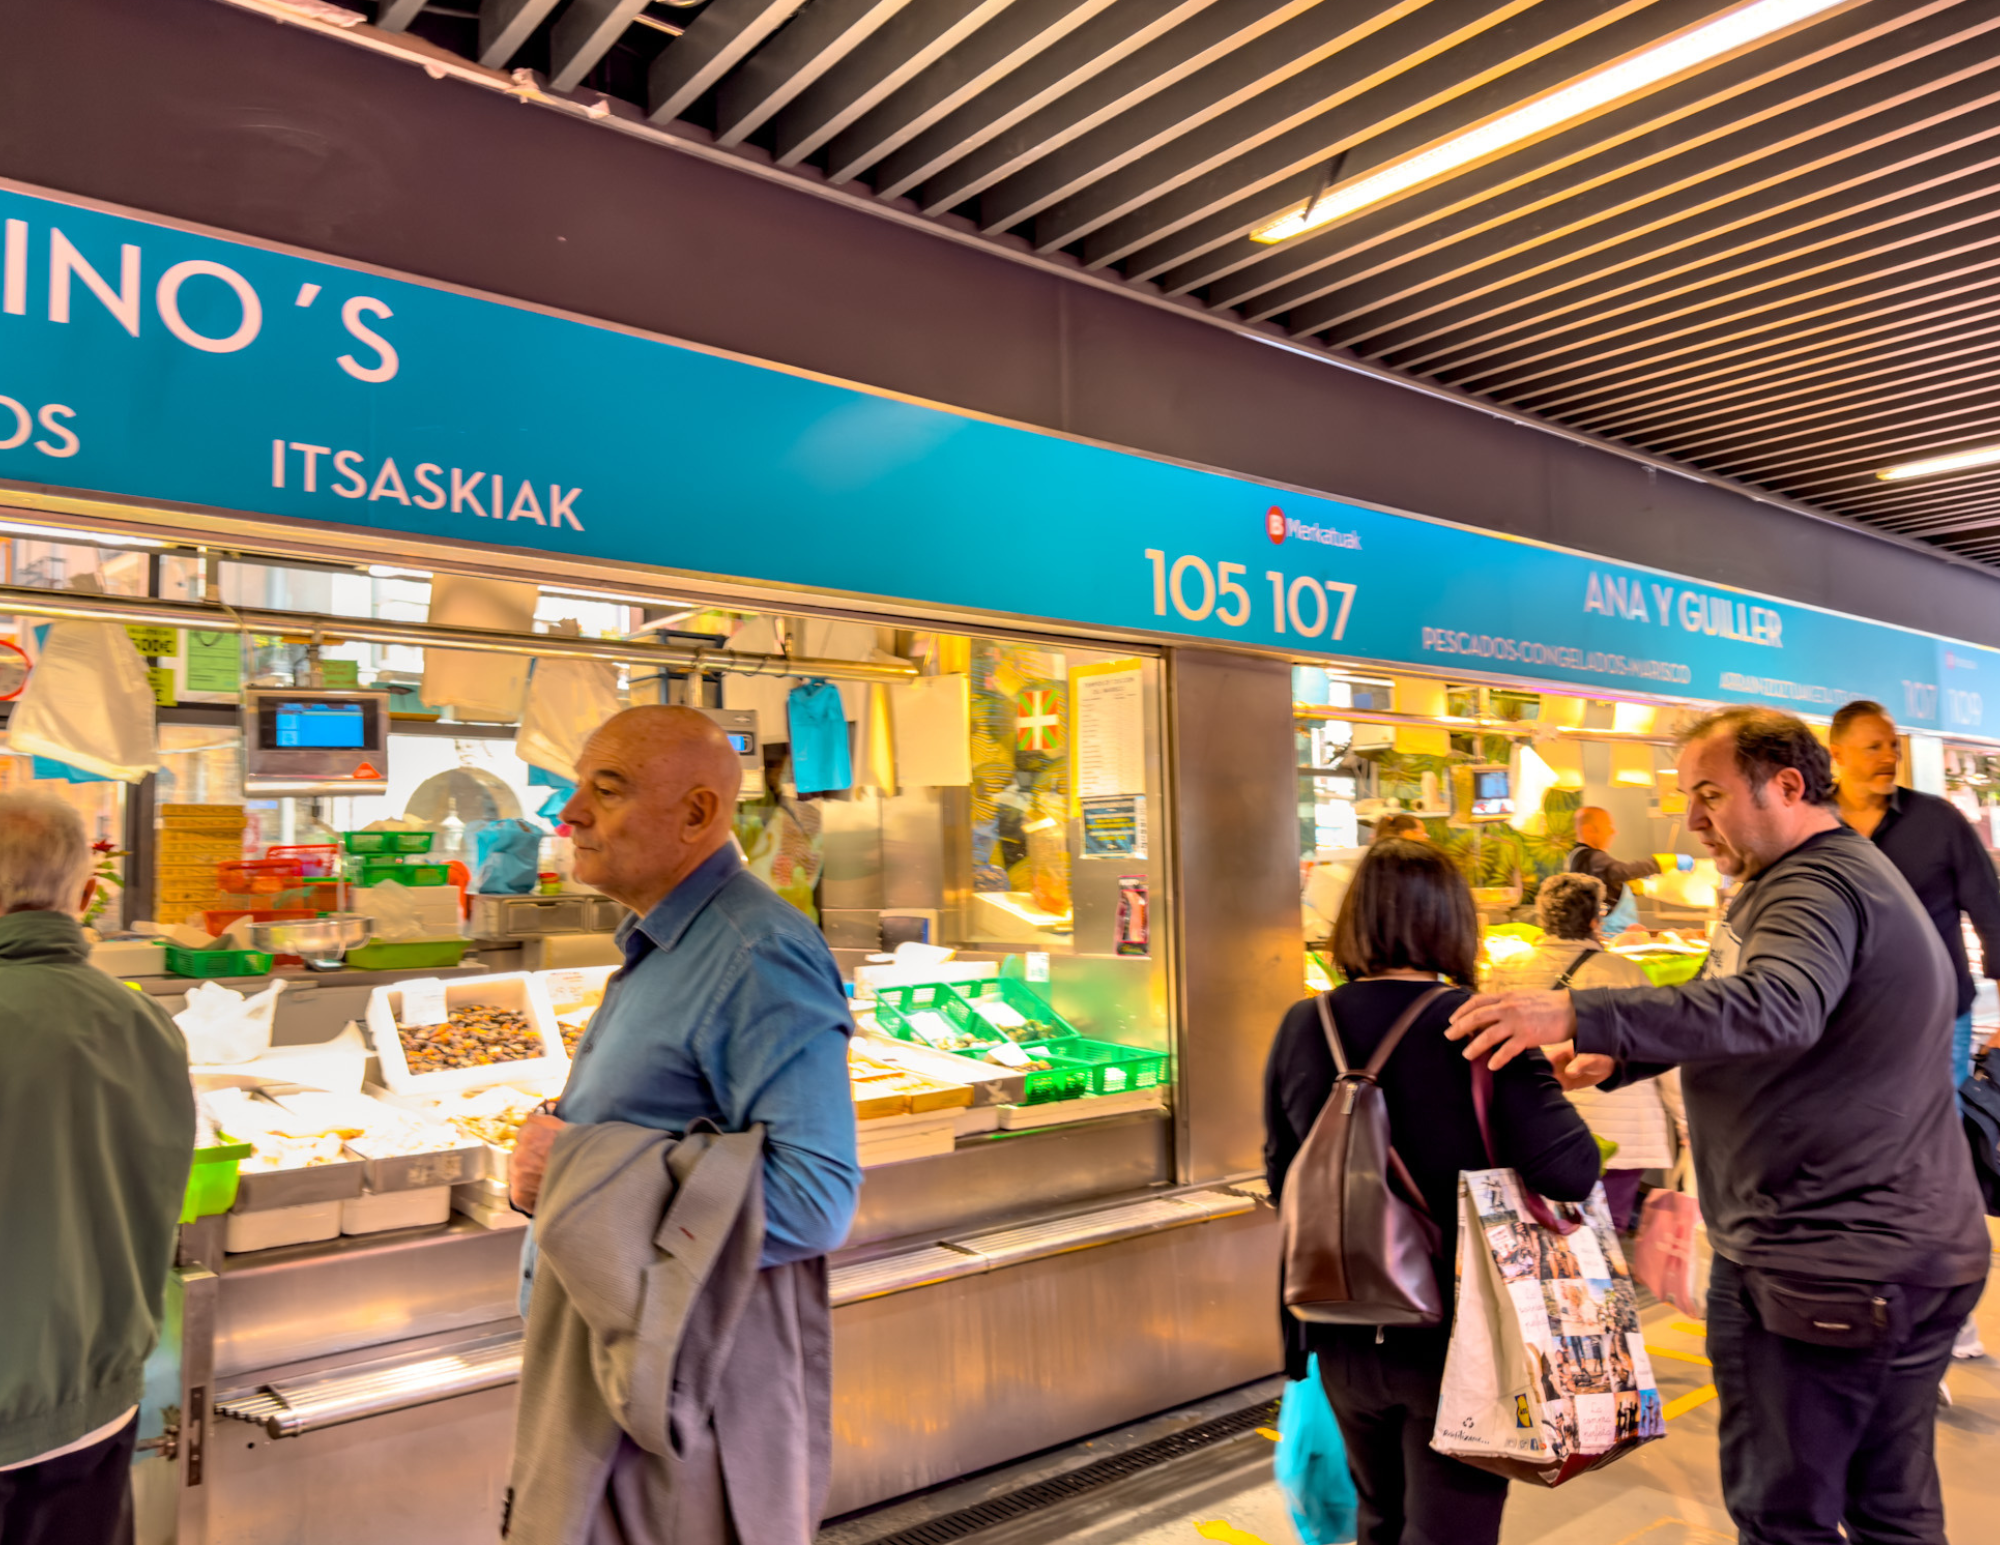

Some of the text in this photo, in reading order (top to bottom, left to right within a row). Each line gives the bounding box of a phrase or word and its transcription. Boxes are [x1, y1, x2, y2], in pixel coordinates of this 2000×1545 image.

[272, 439, 585, 531] ITSASKIAK
[1286, 517, 1363, 550] Merkatuak
[1145, 548, 1251, 627] 105
[1266, 570, 1358, 641] 107
[1583, 570, 1784, 649] ANA Y GUILLER
